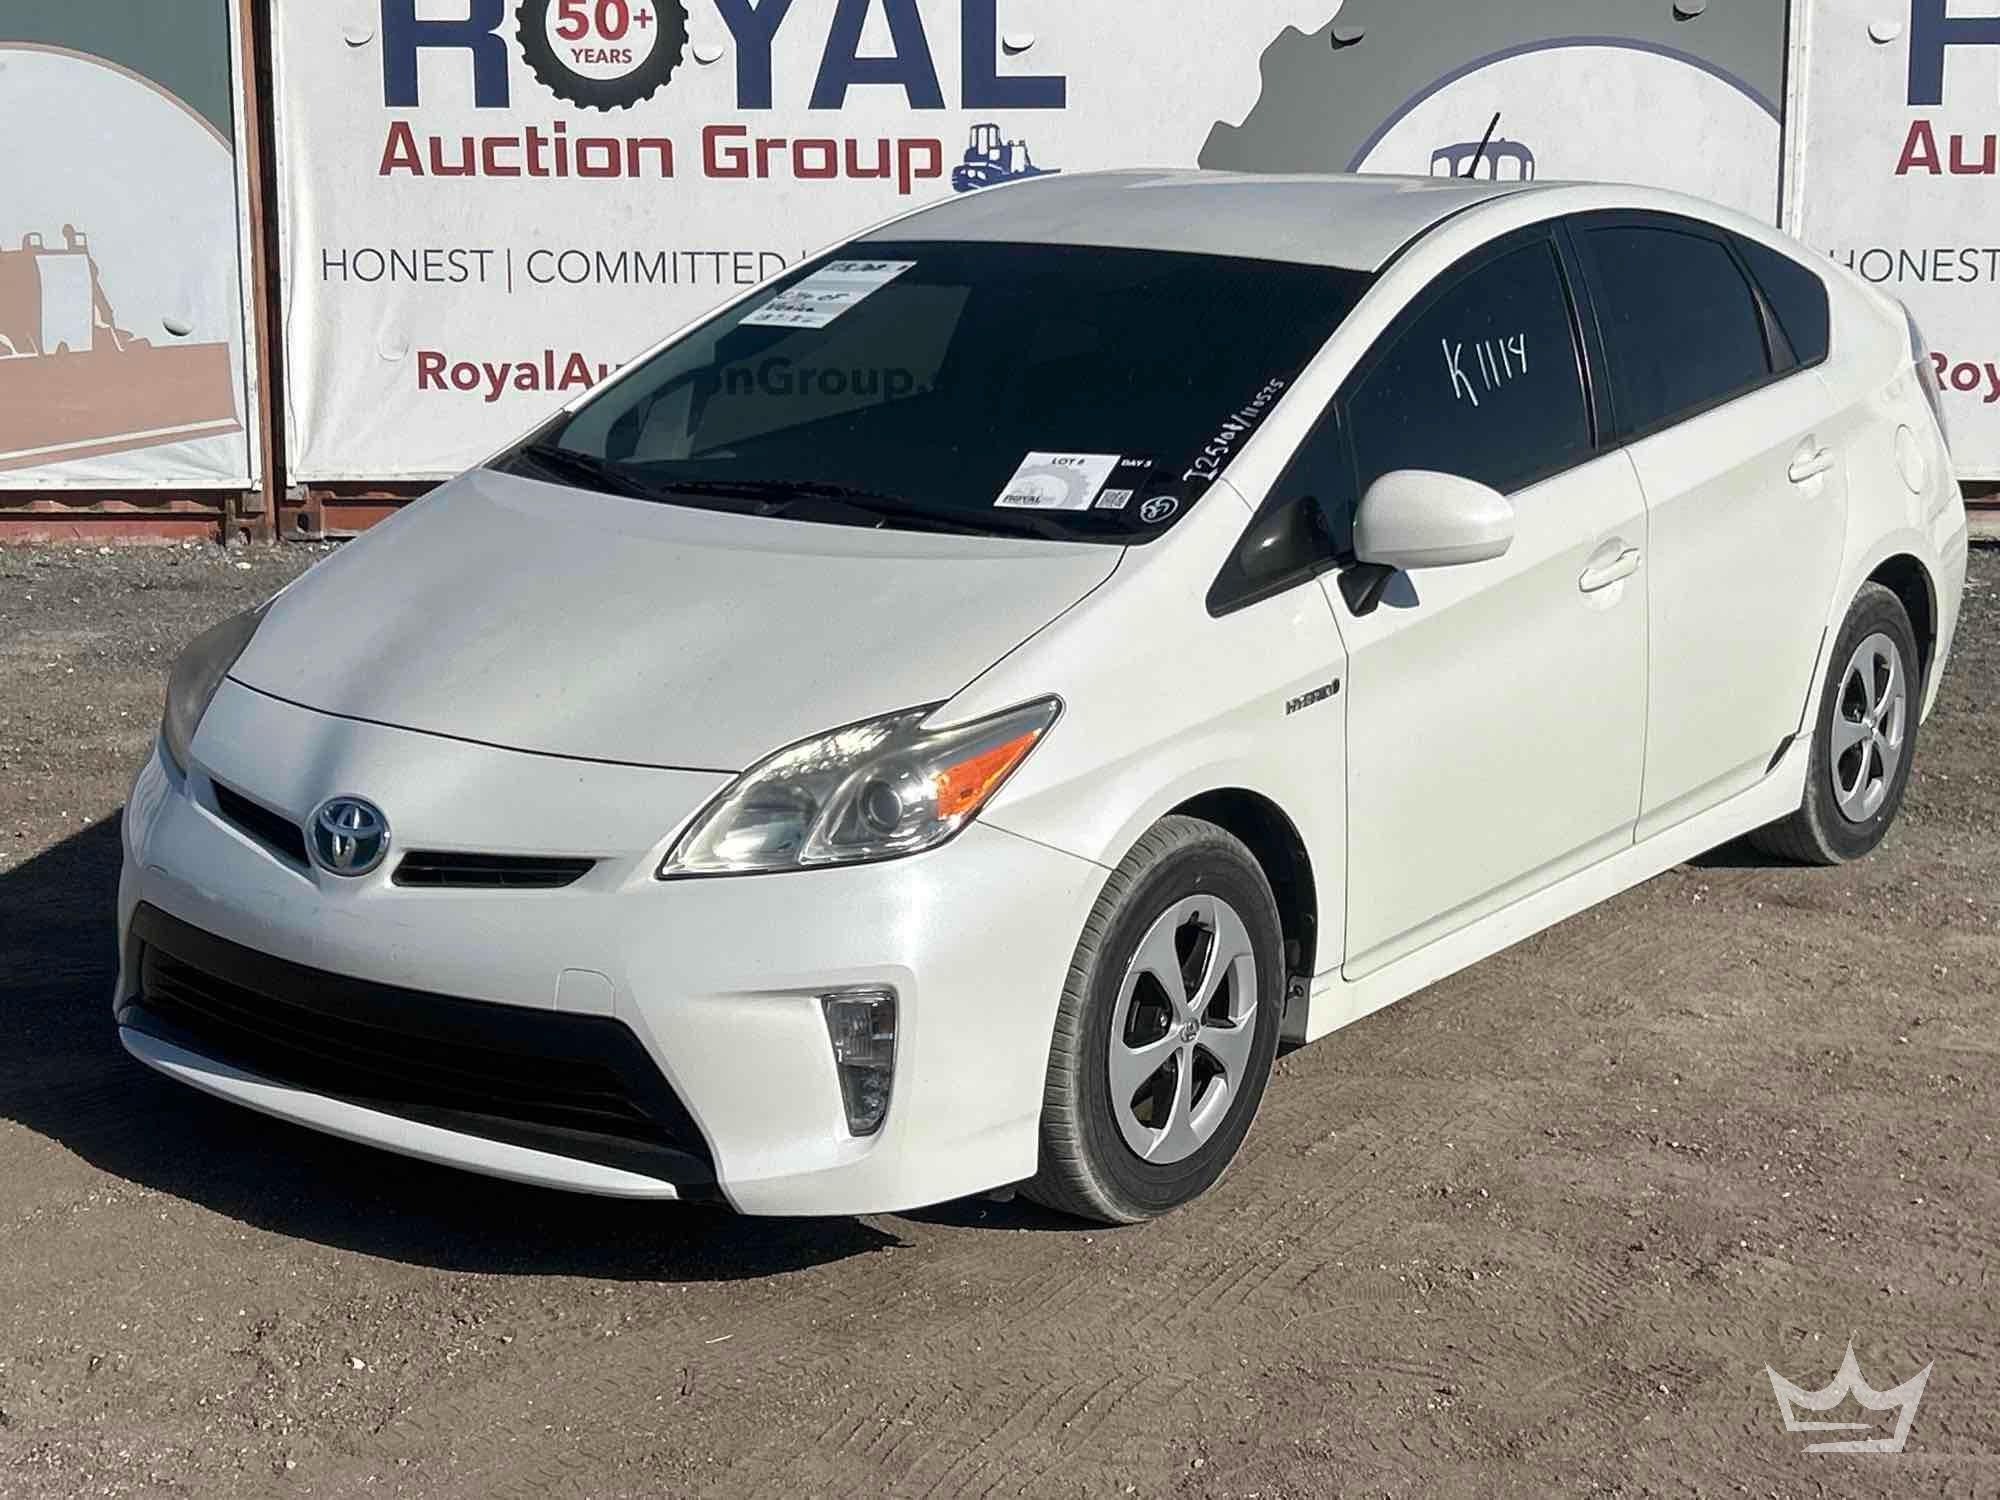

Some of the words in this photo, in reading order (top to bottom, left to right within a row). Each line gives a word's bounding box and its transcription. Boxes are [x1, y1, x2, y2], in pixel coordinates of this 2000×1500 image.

[556, 0, 653, 41] 50+
[571, 49, 632, 64] YEARS
[379, 120, 674, 178] Auction
[702, 125, 942, 195] Group
[321, 248, 494, 284] HONEST
[526, 248, 785, 284] COMMITTED
